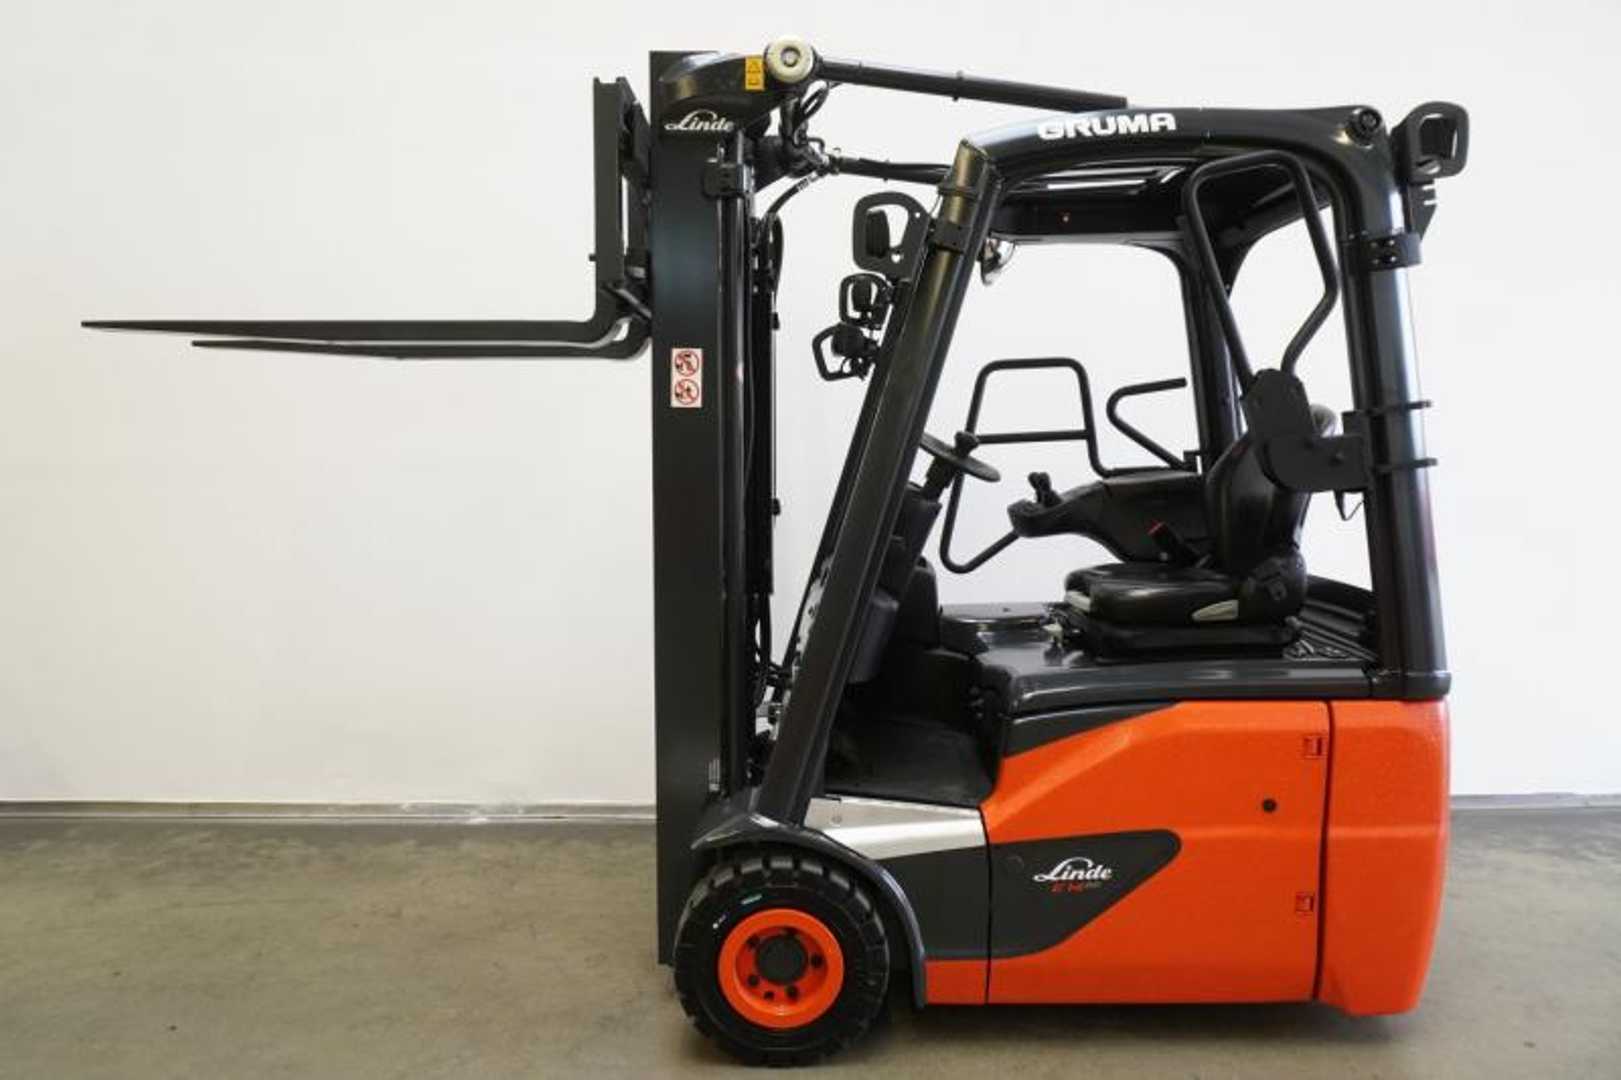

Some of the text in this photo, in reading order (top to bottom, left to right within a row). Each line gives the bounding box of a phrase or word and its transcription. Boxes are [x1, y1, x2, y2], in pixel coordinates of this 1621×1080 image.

[663, 109, 734, 132] Linde
[1037, 112, 1177, 141] GRUMA
[1032, 856, 1113, 882] Linde
